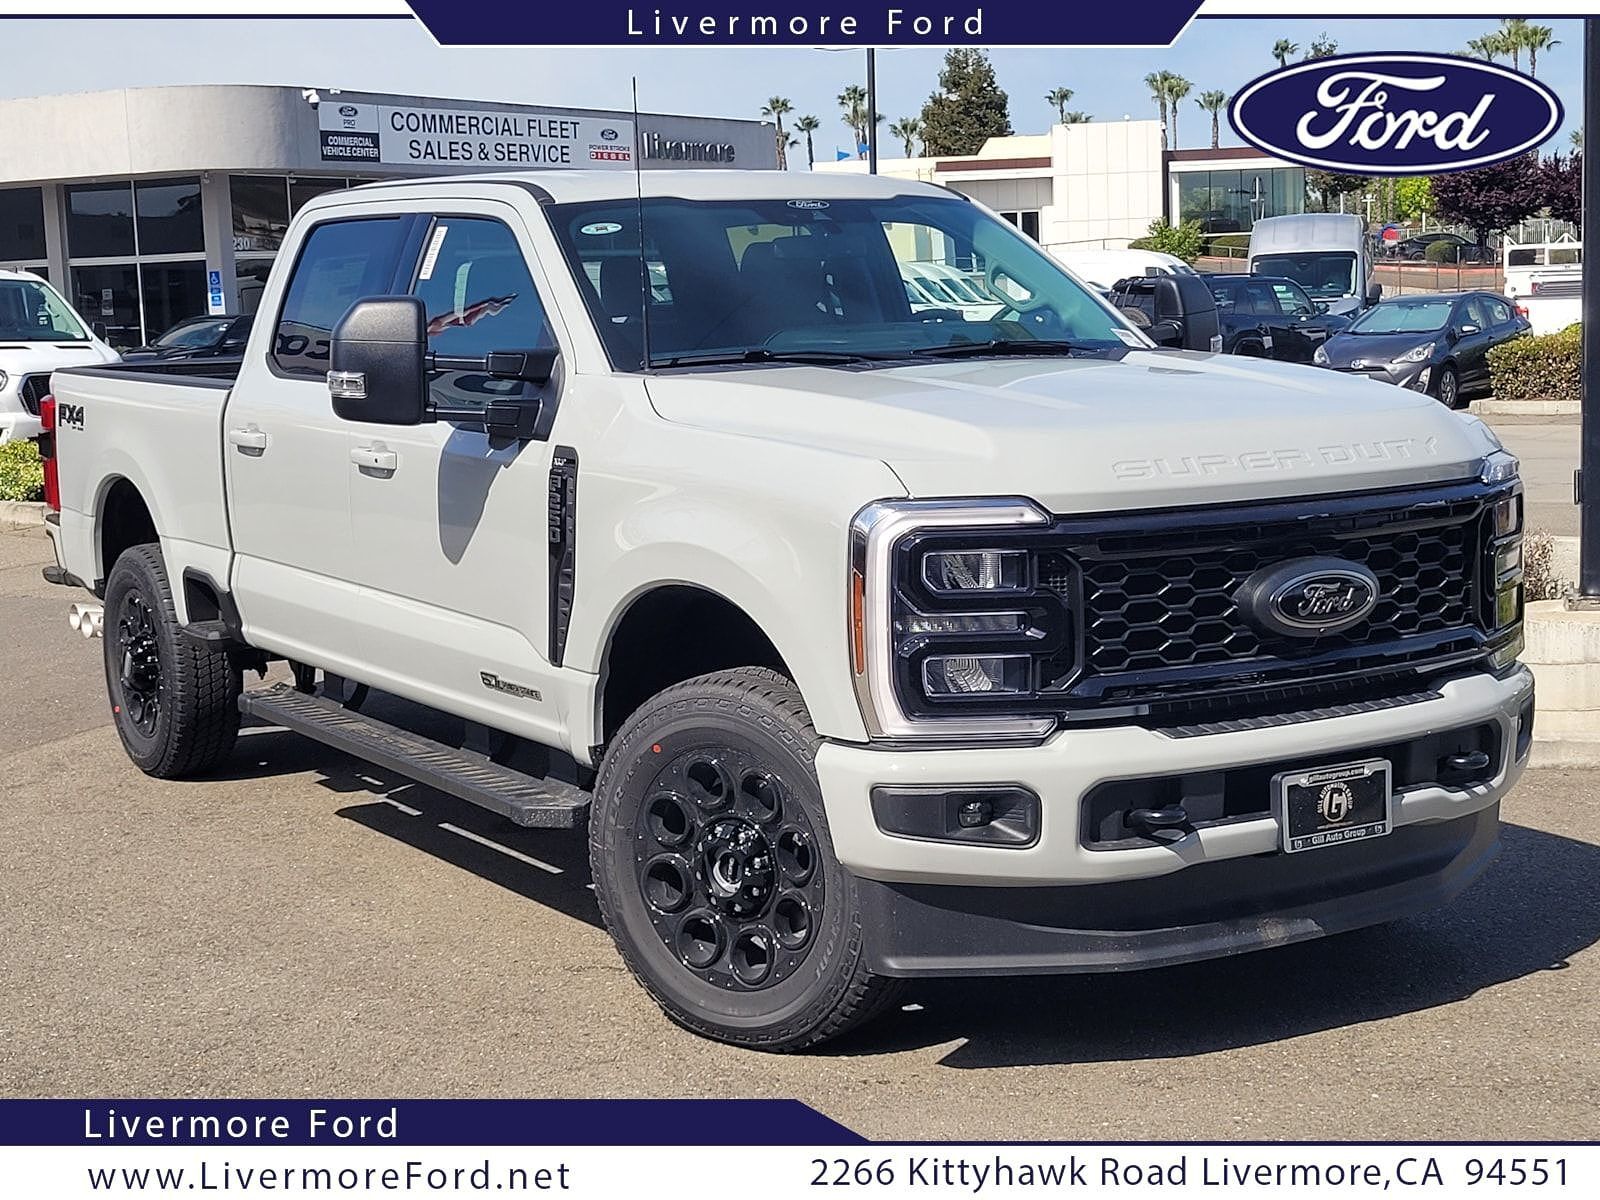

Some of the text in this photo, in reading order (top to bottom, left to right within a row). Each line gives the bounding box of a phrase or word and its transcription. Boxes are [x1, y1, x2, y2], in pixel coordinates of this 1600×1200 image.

[391, 112, 580, 140] COMMERCIAL FLEET
[322, 145, 379, 158] VEHICLE CENTER
[327, 135, 375, 147] COMMERCIAL
[409, 140, 571, 164] SALES & SERVICE
[642, 132, 735, 163] Livermore
[59, 403, 84, 427] FX4
[1111, 436, 1438, 480] SUPER DUTY
[1298, 582, 1355, 616] Ford
[1311, 835, 1325, 845] Gill
[1325, 832, 1343, 843] Auto
[1343, 828, 1367, 840] Group
